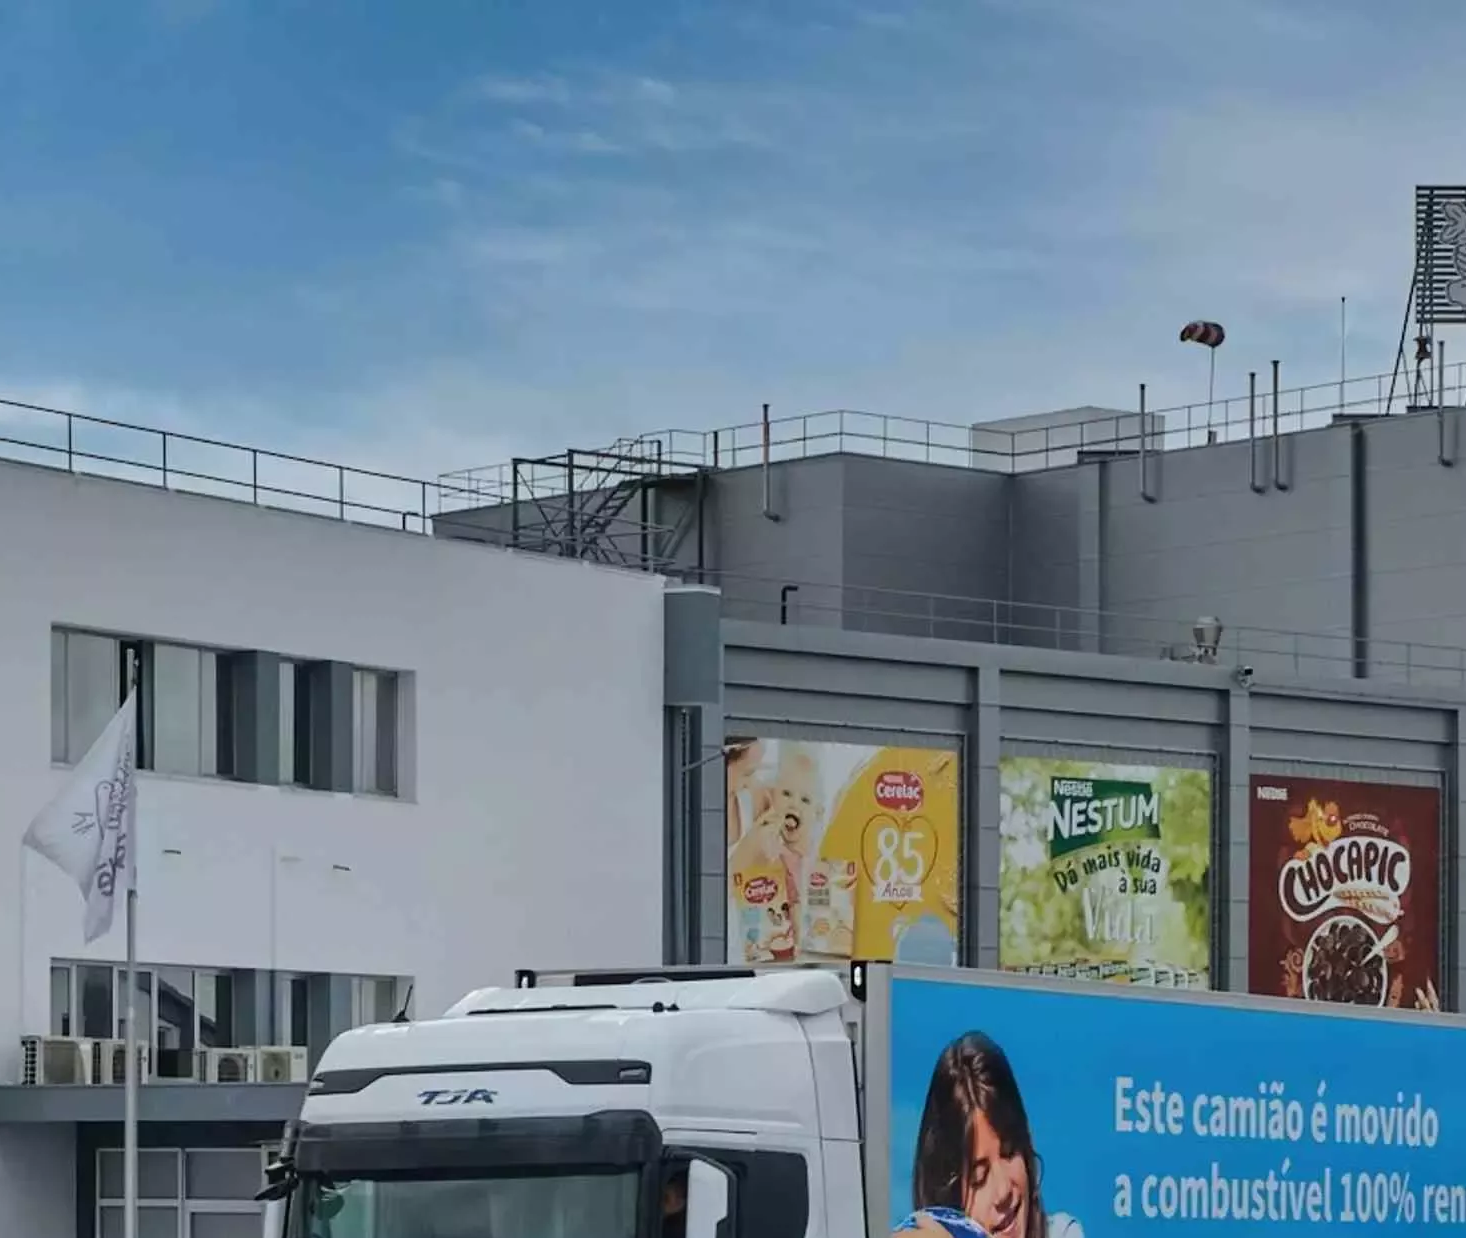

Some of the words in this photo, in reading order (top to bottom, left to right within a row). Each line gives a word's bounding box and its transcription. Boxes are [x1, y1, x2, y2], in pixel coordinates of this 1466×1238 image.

[1047, 793, 1160, 841] NESTUM
[875, 827, 925, 885] 85
[1053, 861, 1079, 895] Dá
[1082, 845, 1121, 876] mais
[1125, 845, 1162, 873] vida
[1118, 868, 1128, 894] à
[1132, 877, 1158, 895] sua
[1282, 840, 1406, 916] CHOCAPIC
[417, 1088, 498, 1105] TJA
[1115, 1076, 1184, 1135] Este
[1192, 1079, 1304, 1141] camião
[1310, 1079, 1328, 1143] é
[1335, 1091, 1439, 1148] movido
[1113, 1173, 1133, 1218] a
[1141, 1157, 1332, 1223] combustível
[1340, 1171, 1416, 1224] 100%
